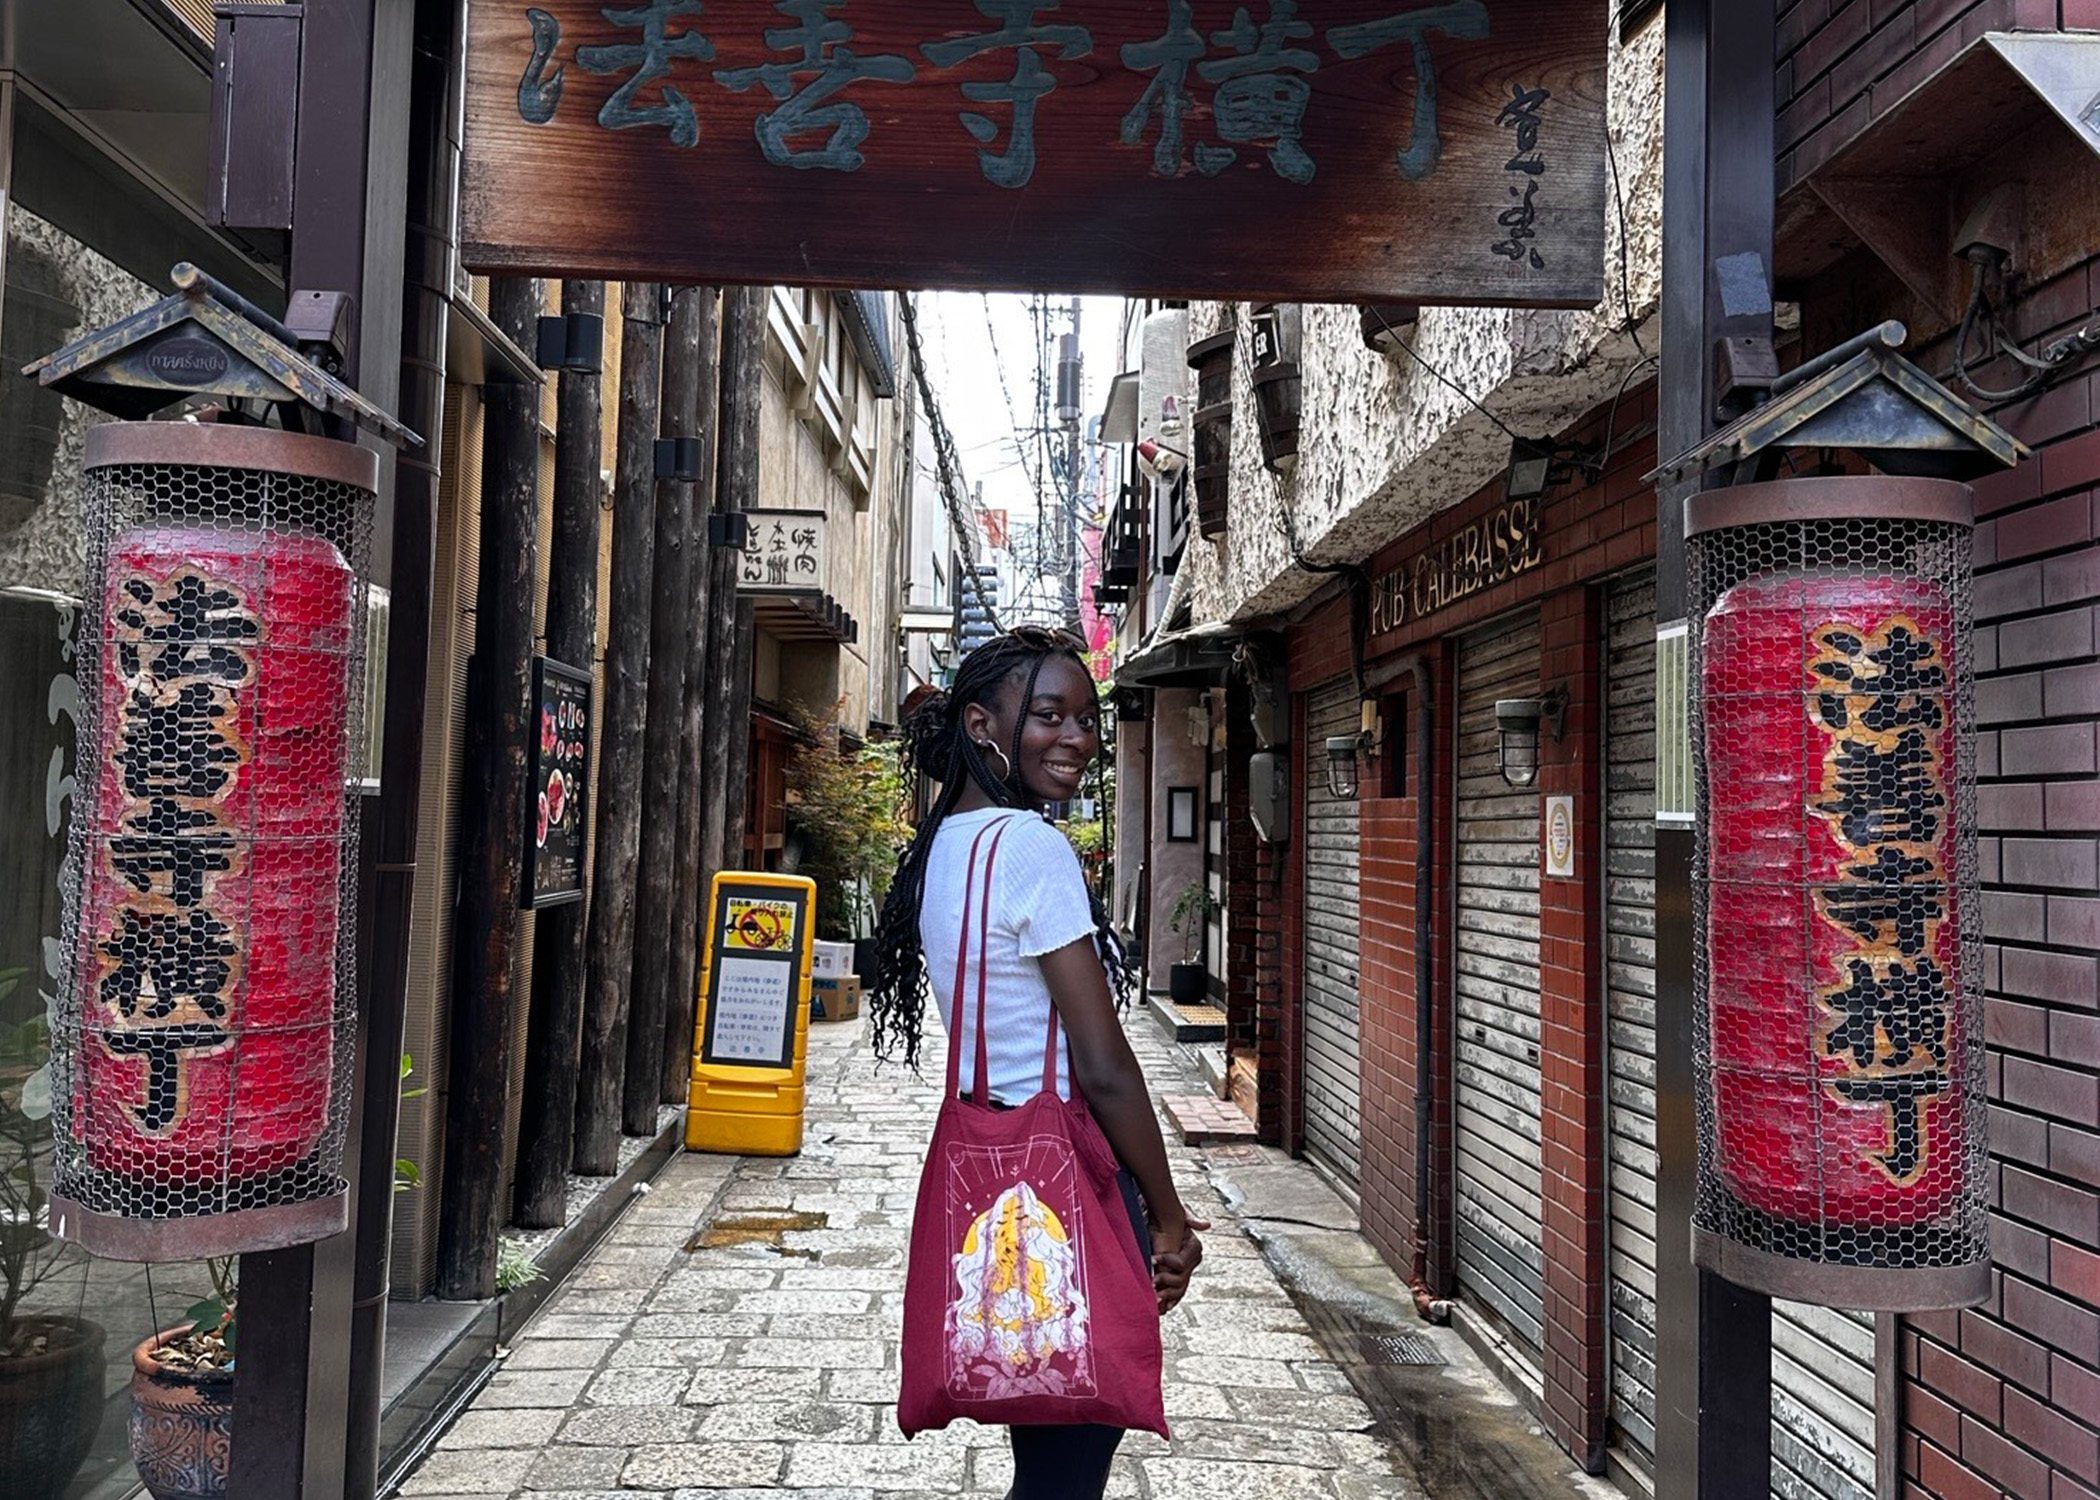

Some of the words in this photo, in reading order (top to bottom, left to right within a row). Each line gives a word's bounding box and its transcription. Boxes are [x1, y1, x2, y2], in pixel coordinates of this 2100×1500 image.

[518, 0, 1490, 189] 法善寺横丁
[1372, 566, 1406, 636] PUB
[1414, 500, 1542, 617] CALEBASSE
[99, 572, 260, 1133] 法善寺横丁
[1813, 623, 1951, 1181] 法善寺横丁
